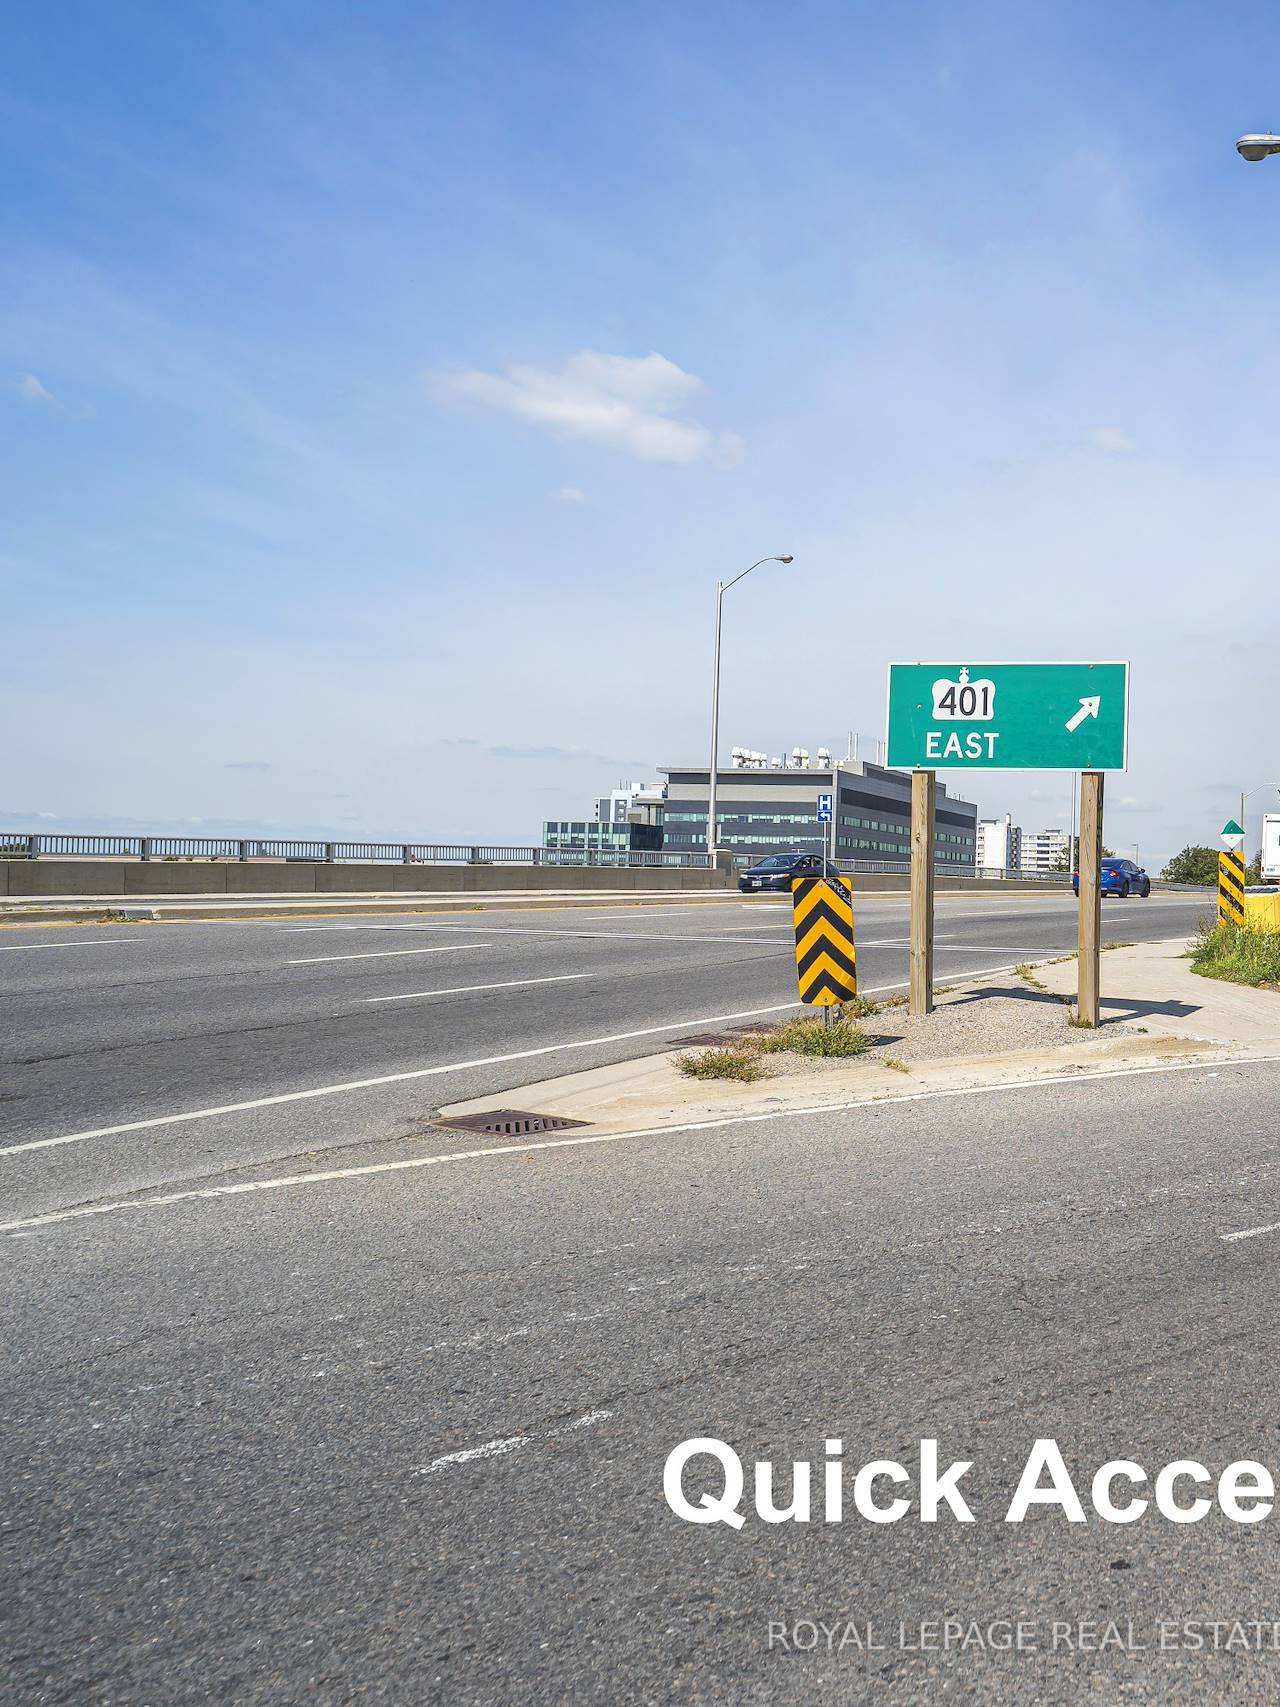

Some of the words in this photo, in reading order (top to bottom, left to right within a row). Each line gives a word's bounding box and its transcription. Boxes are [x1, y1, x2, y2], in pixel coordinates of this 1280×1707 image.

[938, 686, 989, 716] 401
[926, 732, 1000, 758] EAST
[820, 795, 831, 810] H
